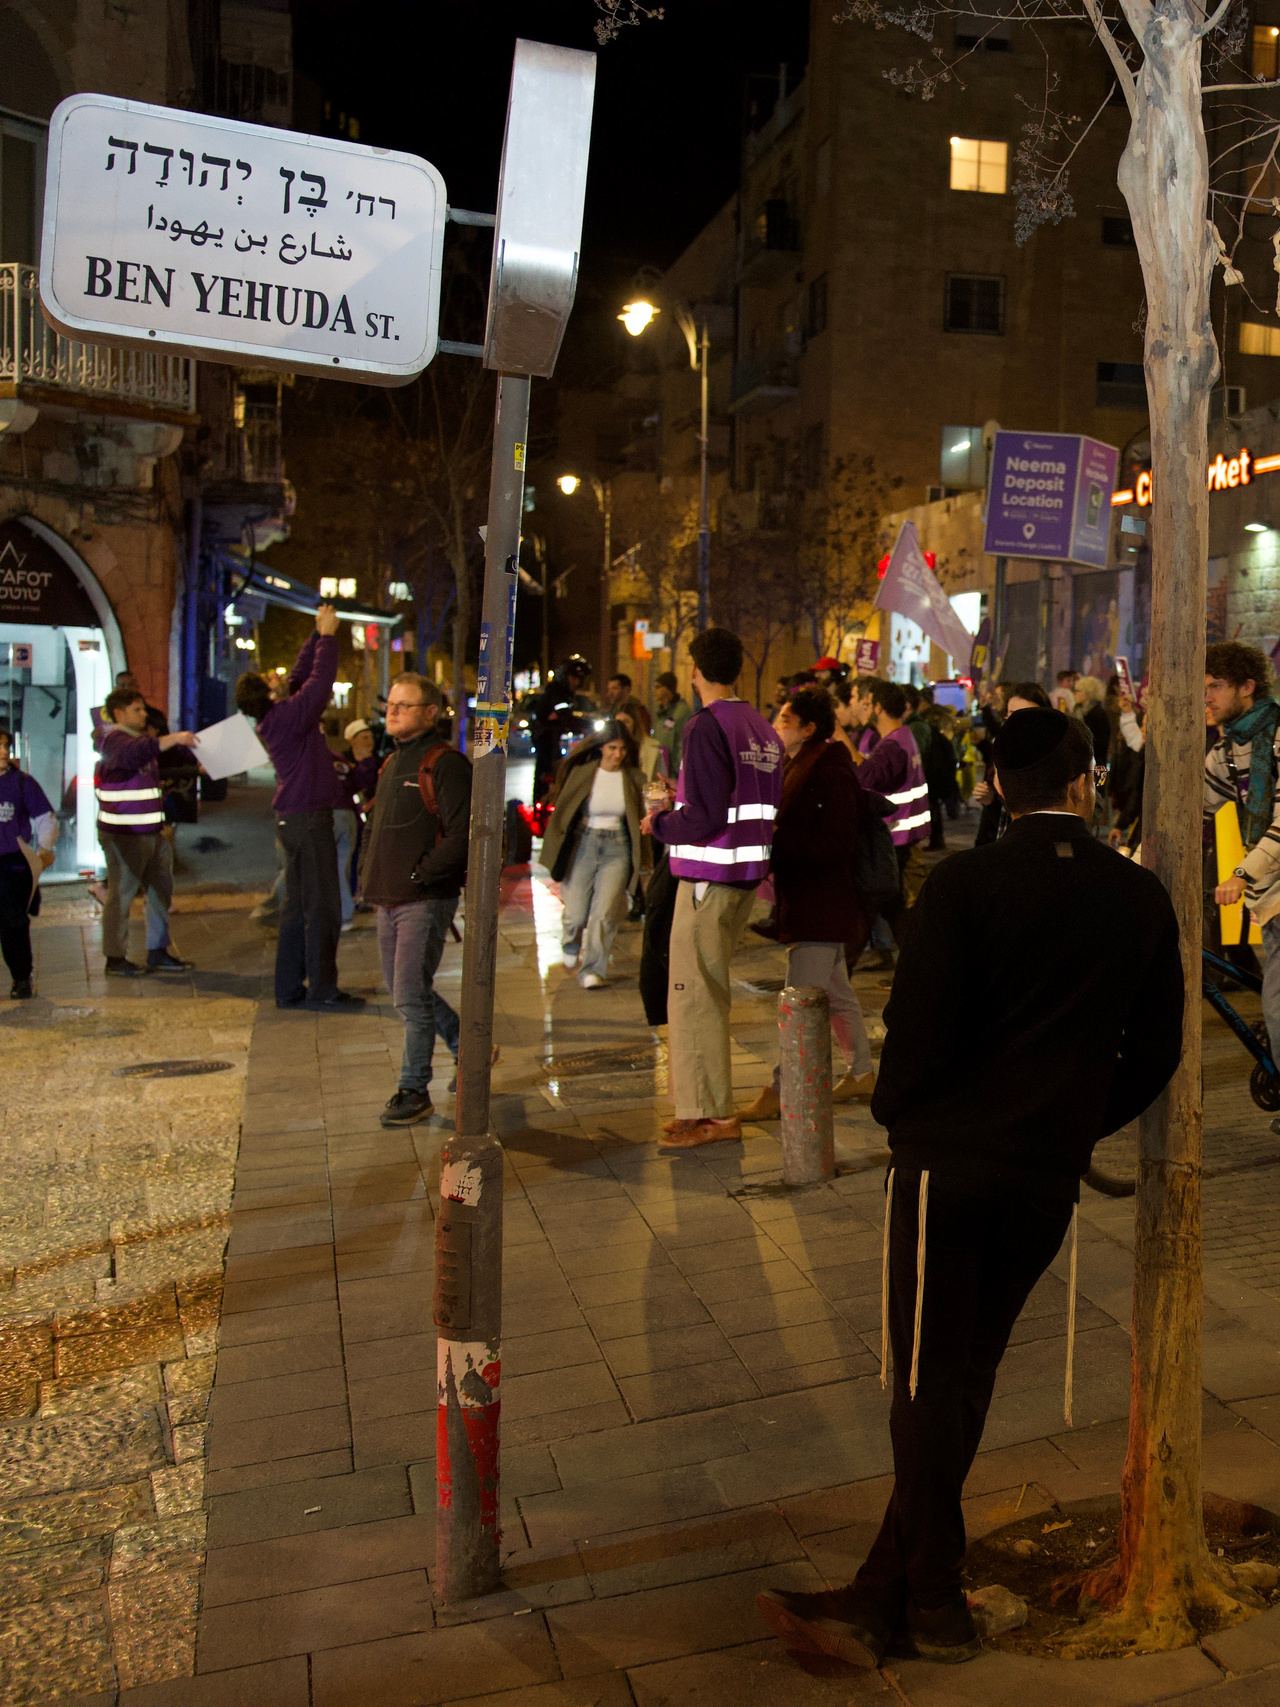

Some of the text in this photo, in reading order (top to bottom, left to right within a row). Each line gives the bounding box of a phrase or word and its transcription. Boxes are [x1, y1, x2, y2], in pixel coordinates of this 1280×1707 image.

[147, 205, 353, 264] شارع بن يهودا
[84, 256, 401, 341] BEN YEHUDA ST.
[1006, 457, 1066, 475] Neema
[1004, 475, 1065, 492] Deposit
[1002, 492, 1064, 509] Location
